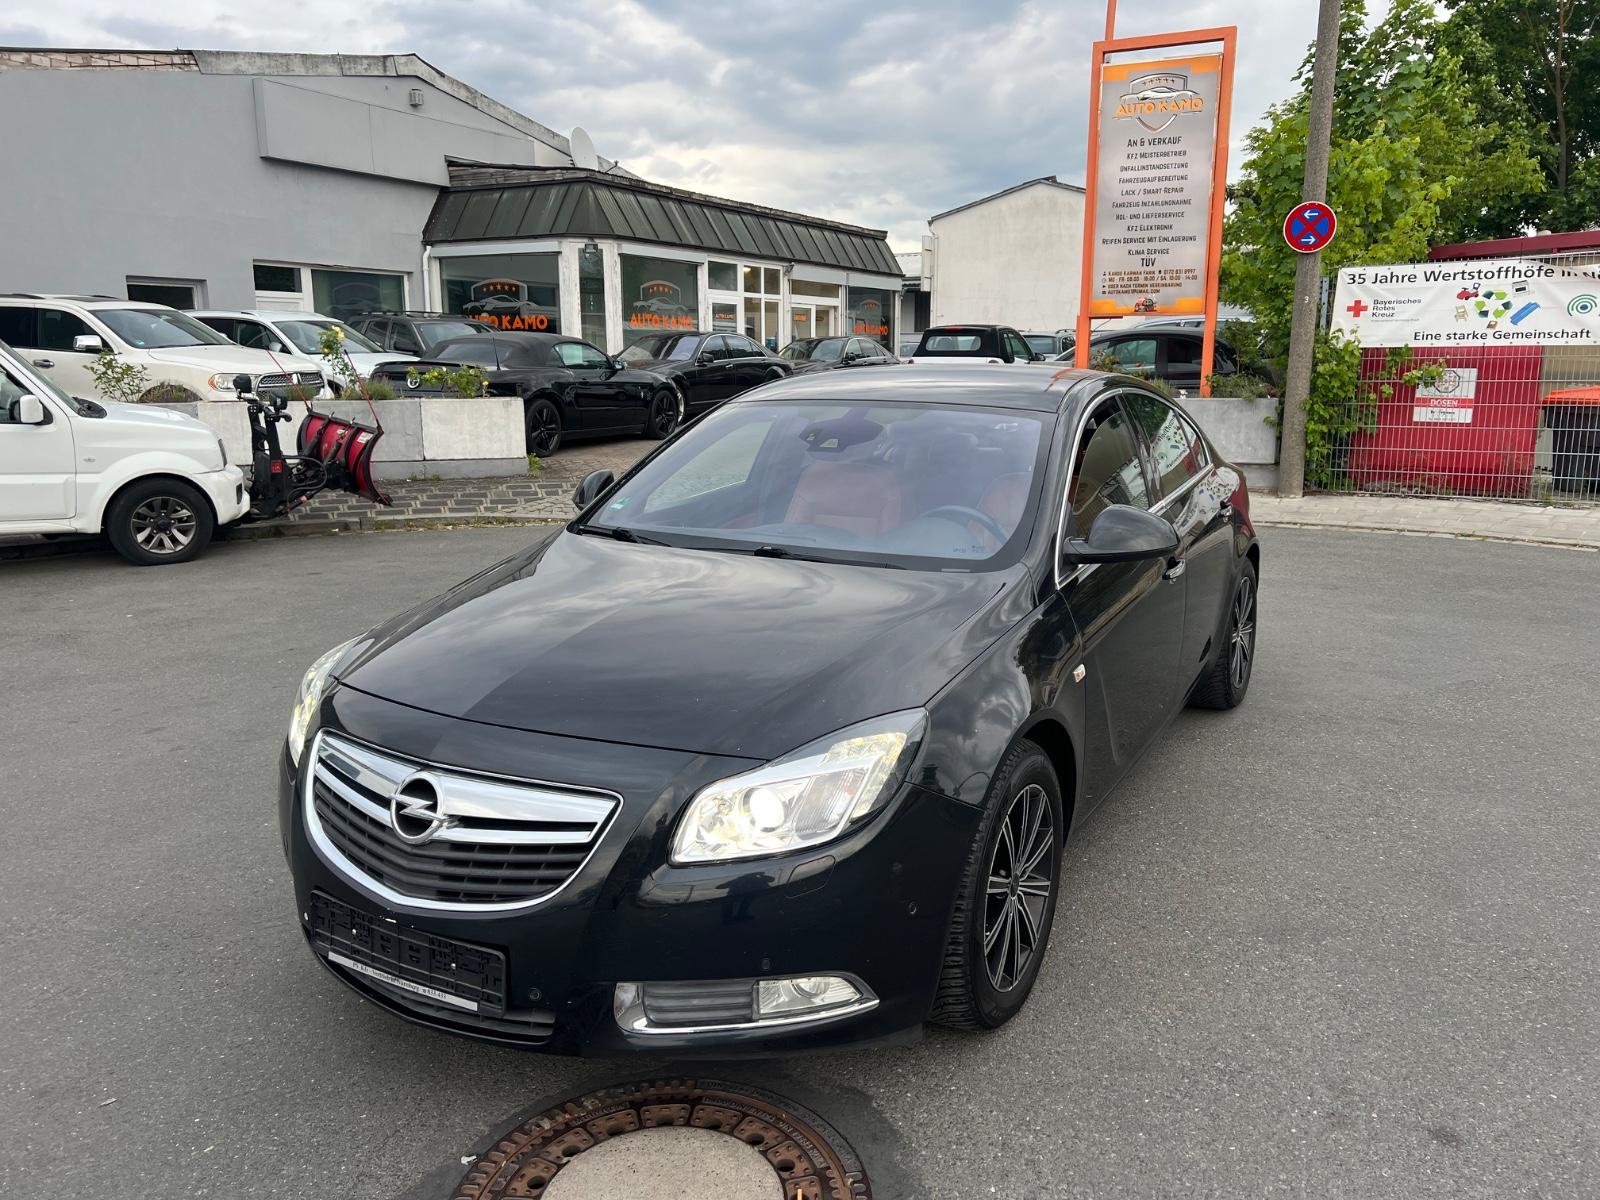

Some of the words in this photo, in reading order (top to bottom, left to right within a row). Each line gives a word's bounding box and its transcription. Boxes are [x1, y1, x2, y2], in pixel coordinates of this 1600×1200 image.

[1112, 102, 1155, 117] AUTO
[1158, 98, 1204, 114] KAMO
[1140, 138, 1145, 146] &
[1148, 136, 1182, 146] VERKAUF
[1140, 150, 1187, 159] MEISTERBETRIEB
[1120, 162, 1188, 172] UNFALLINSTANDSETZUNG
[1118, 174, 1188, 184] FAHRZEUGAUFBEREITUNG
[1158, 235, 1196, 243] EINLAGERUNG
[1140, 256, 1156, 267] TÜV
[1347, 274, 1366, 285] 35
[1372, 272, 1417, 284] Jahre
[1424, 265, 1554, 282] Wertstoffhöfe
[502, 314, 548, 330] KAMO
[630, 313, 659, 328] AUTO
[662, 314, 693, 330] KAMO
[1414, 331, 1442, 341] Eine
[1446, 330, 1488, 340] starke
[1492, 328, 1592, 340] Gemeinschaft
